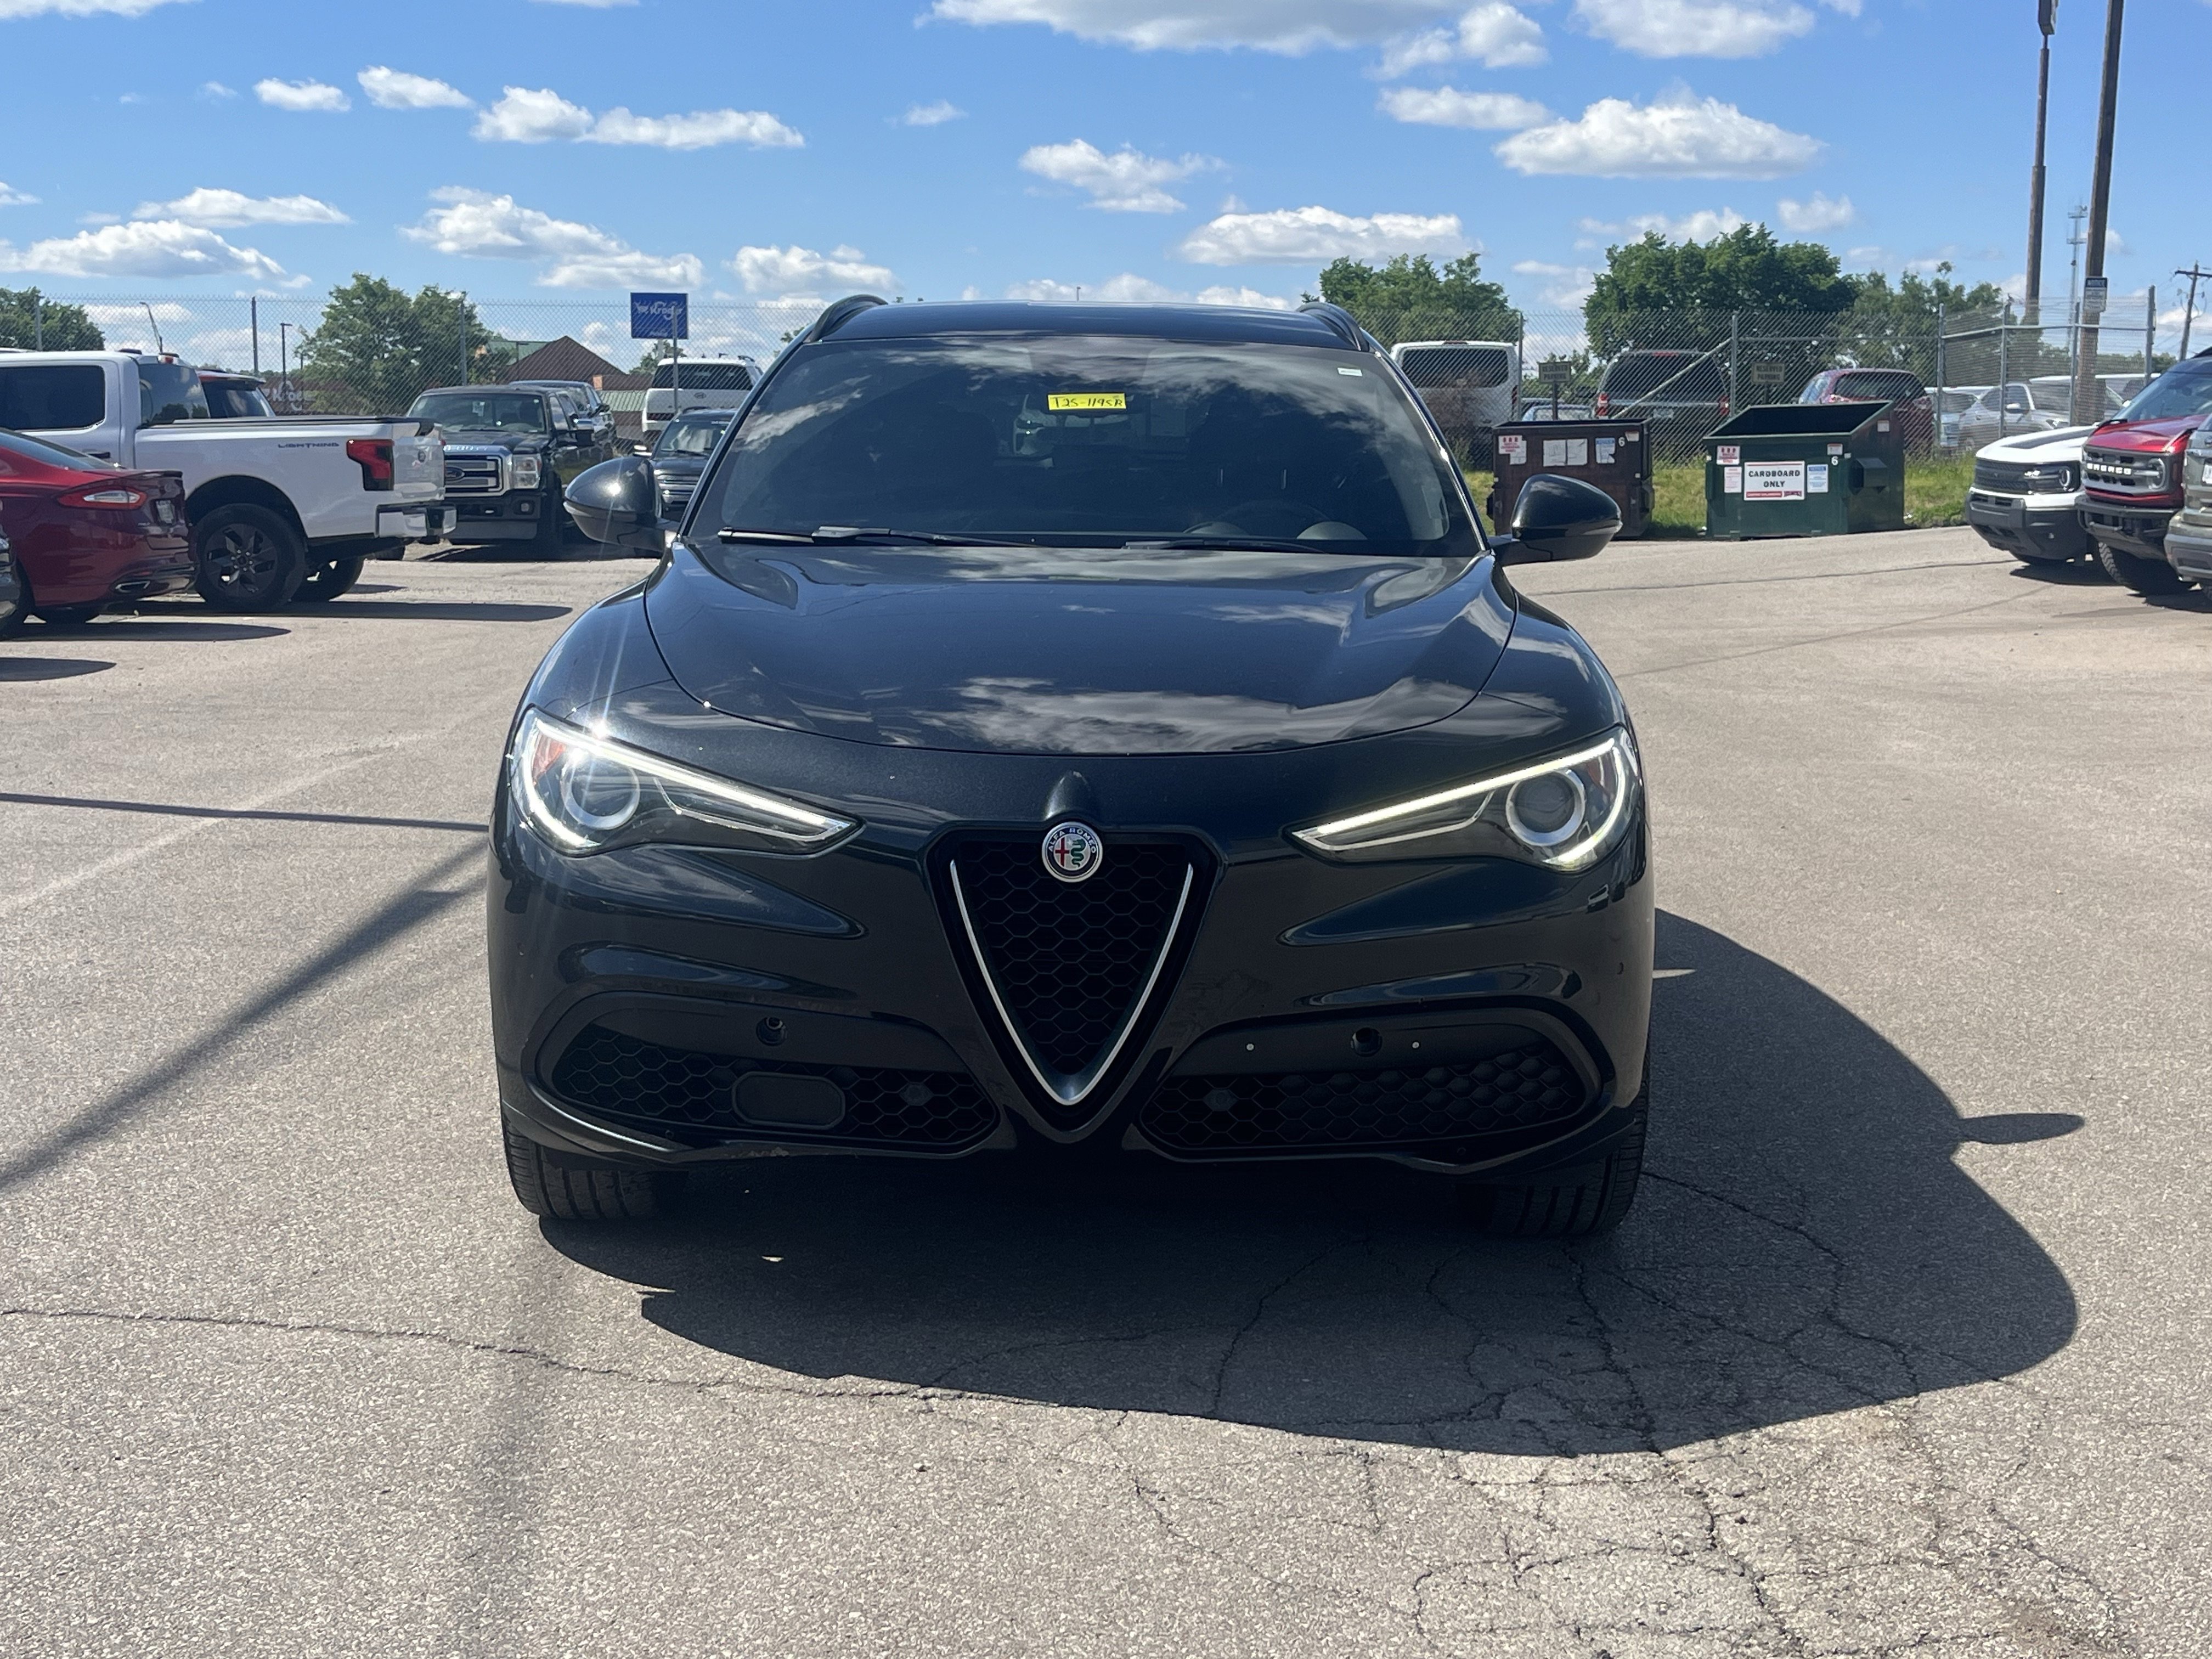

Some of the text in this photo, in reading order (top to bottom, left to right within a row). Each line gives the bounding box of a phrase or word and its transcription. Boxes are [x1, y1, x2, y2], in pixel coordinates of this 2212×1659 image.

[650, 301, 682, 320] Krogr
[1831, 456, 1838, 465] 6
[1048, 828, 1097, 853] ALFA ROMEO
